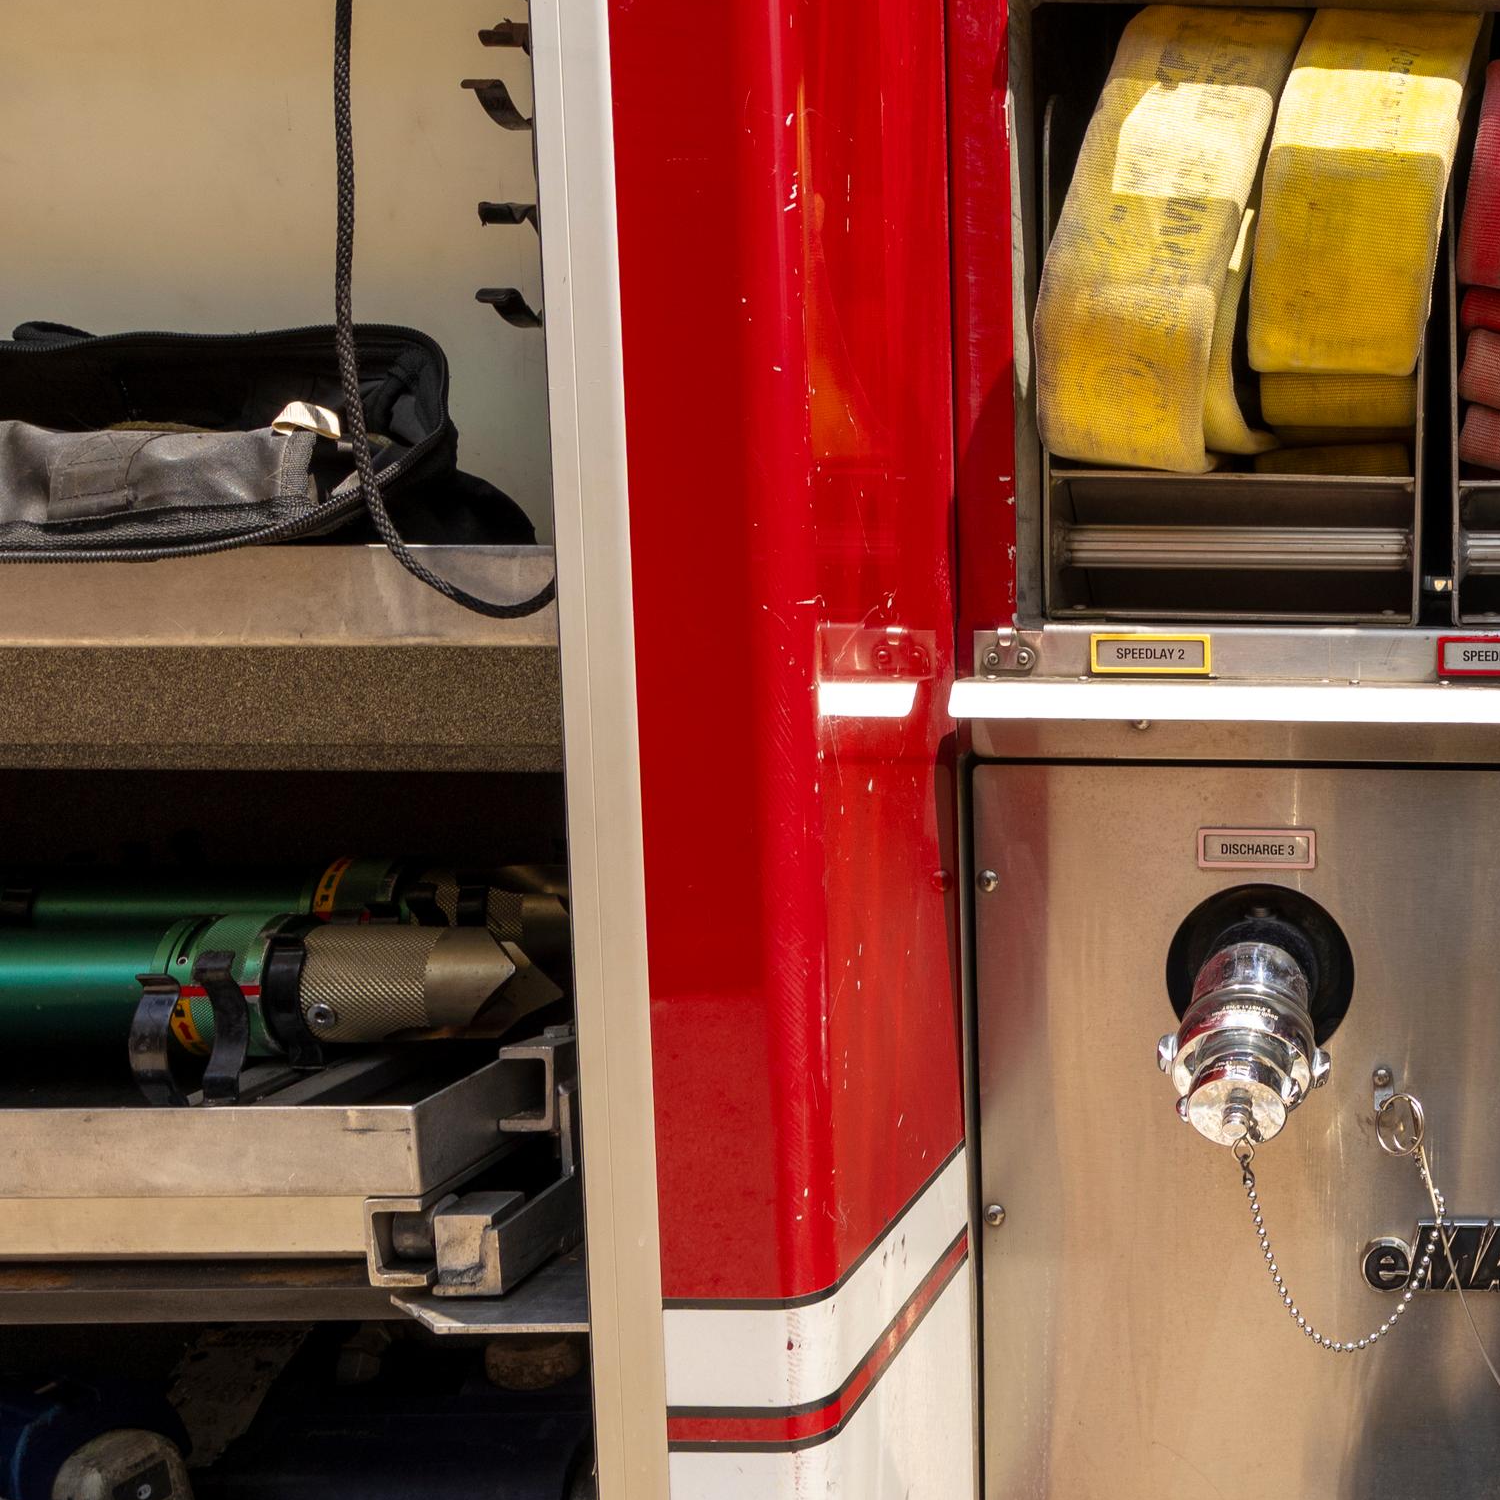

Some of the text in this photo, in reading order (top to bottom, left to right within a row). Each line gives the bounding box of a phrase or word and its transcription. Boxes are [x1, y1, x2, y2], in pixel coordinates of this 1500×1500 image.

[1116, 648, 1185, 660] SPEEDLAY 2
[1221, 843, 1295, 855] DISCHARGE 3
